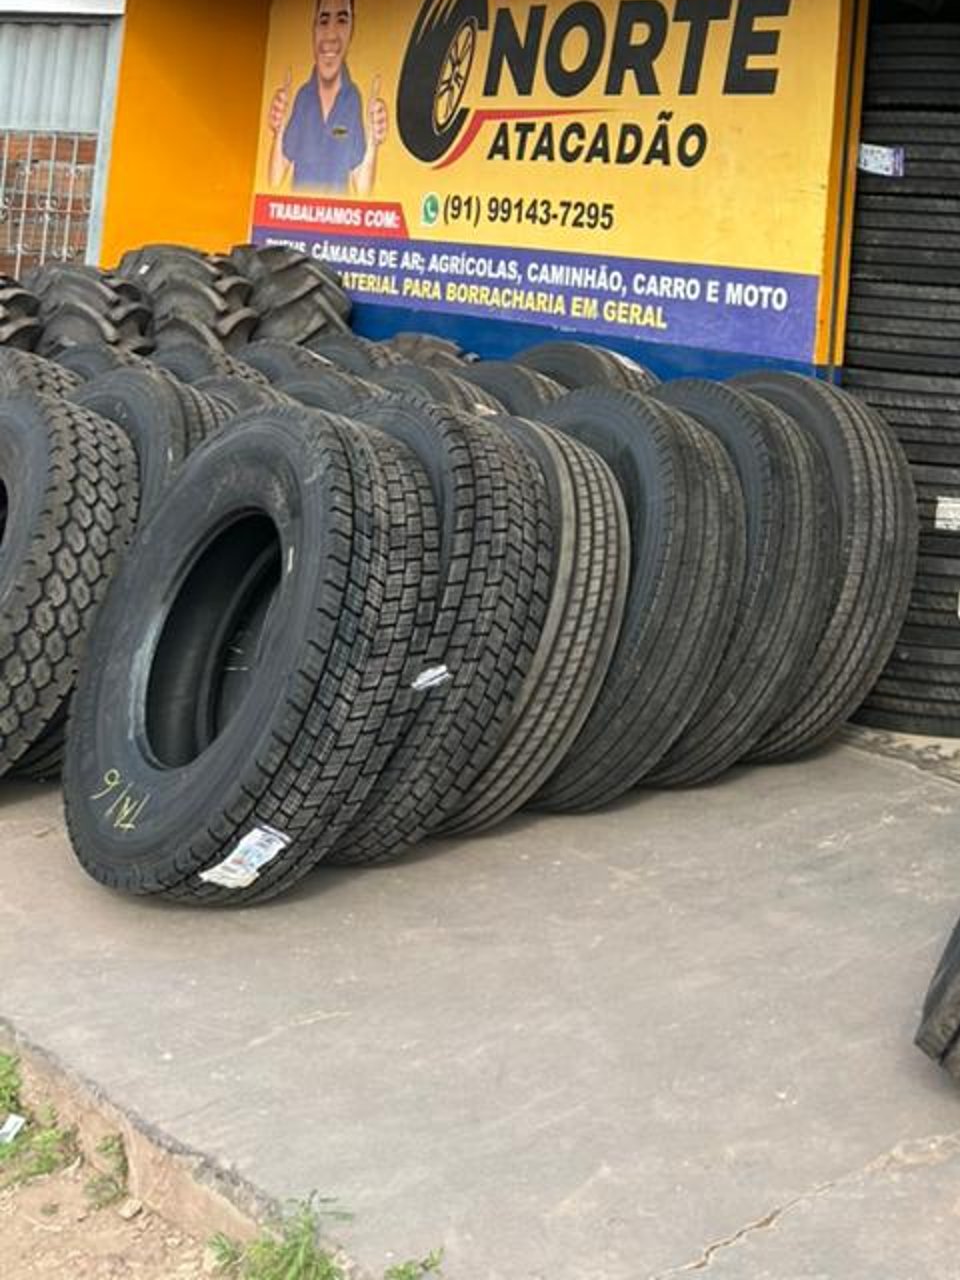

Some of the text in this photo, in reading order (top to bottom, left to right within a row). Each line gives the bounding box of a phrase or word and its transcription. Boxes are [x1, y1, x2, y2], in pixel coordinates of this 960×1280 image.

[488, 111, 707, 167] ATACADÃO
[269, 202, 400, 229] TRABALHAMOS COM:
[443, 194, 614, 230] (91) 99143-7295
[312, 240, 375, 267] CÂMARAS
[378, 249, 398, 269] DE
[400, 252, 425, 273] AR;
[428, 250, 522, 284] AGRÍCOLAS,
[527, 262, 627, 297] CAMINHÃO,
[633, 274, 700, 300] CARRO
[706, 280, 719, 303] E
[726, 283, 788, 311] MOTO
[338, 271, 668, 329] ATERIAL PARA BORRACHARIA EM GERAL
